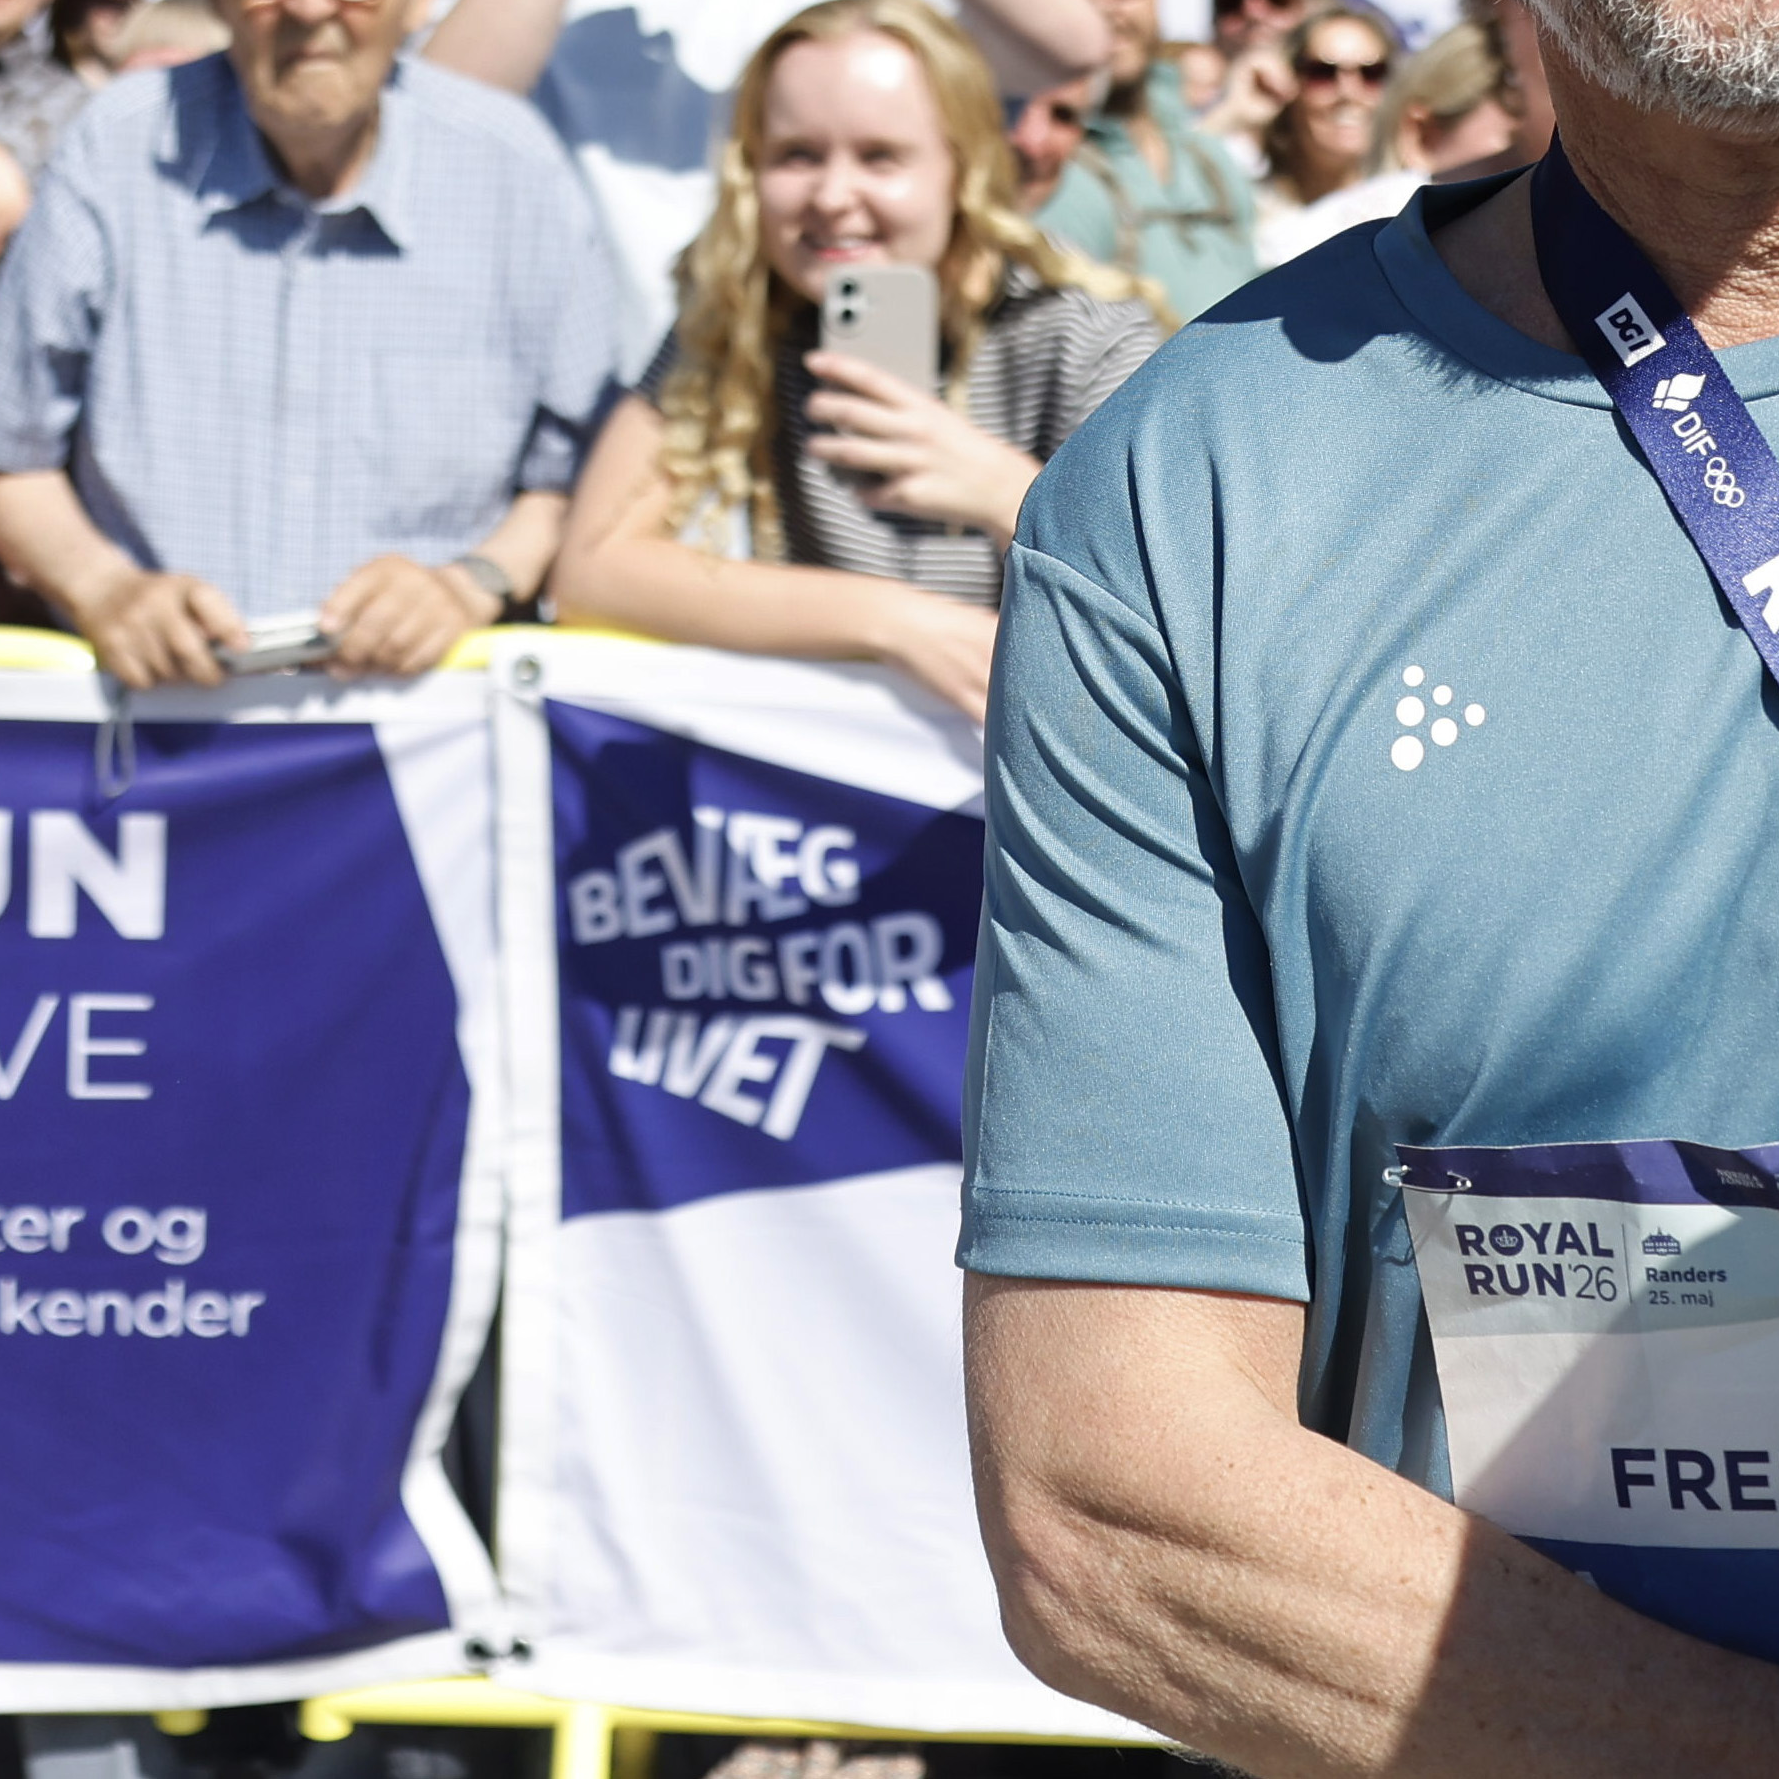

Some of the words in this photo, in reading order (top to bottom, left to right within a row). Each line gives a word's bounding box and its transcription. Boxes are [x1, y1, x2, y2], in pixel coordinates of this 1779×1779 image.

[1606, 307, 1652, 352] DGI
[1671, 411, 1717, 456] DIF
[660, 935, 778, 1002] DIG
[778, 911, 954, 1015] FOR
[102, 1205, 208, 1266] og
[1454, 1222, 1615, 1259] ROYAL
[1645, 1267, 1728, 1284] Randers
[1648, 1291, 1676, 1306] 25.
[1680, 1290, 1715, 1308] maj
